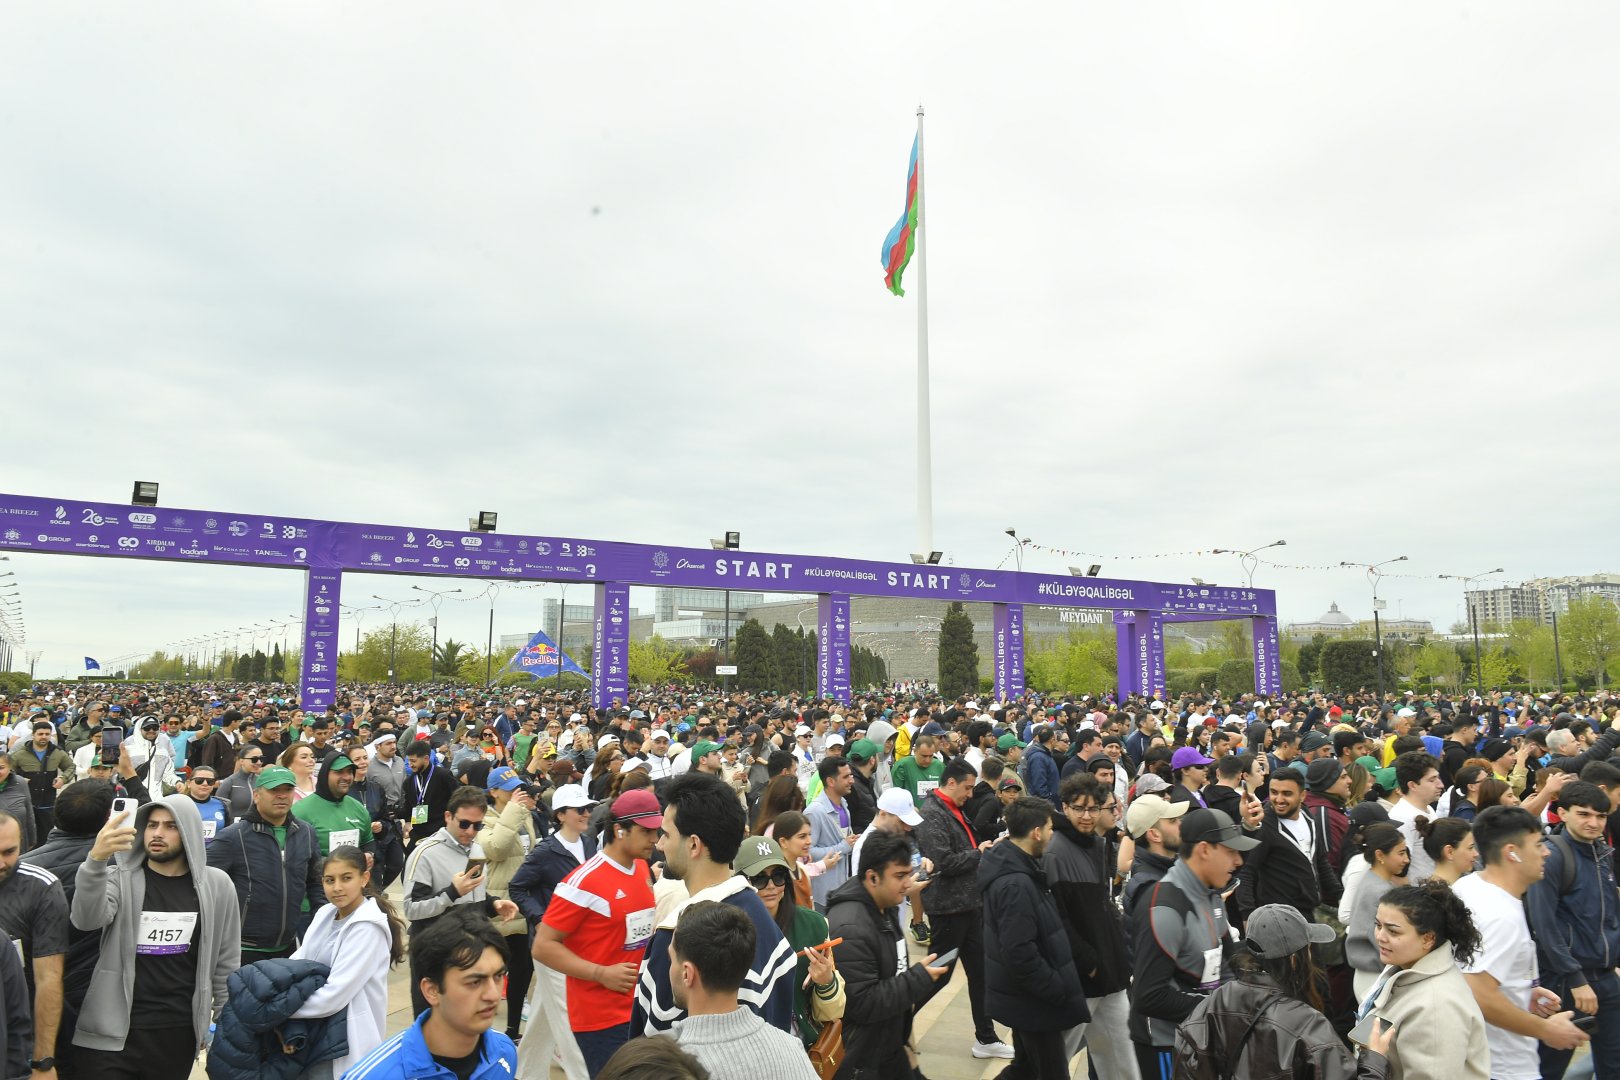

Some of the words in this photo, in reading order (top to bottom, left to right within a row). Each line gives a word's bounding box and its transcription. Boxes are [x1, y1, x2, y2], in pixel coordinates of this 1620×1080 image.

[10, 508, 39, 516] BREEZE
[117, 536, 140, 548] GO
[454, 557, 471, 567] GO
[715, 558, 793, 579] START
[887, 571, 951, 590] START
[1038, 581, 1135, 600] #KÜLƏYƏQALİBGƏL
[1060, 611, 1103, 624] MEYDANI
[522, 655, 544, 667] Red
[544, 655, 565, 666] Bul
[147, 929, 184, 942] 4157
